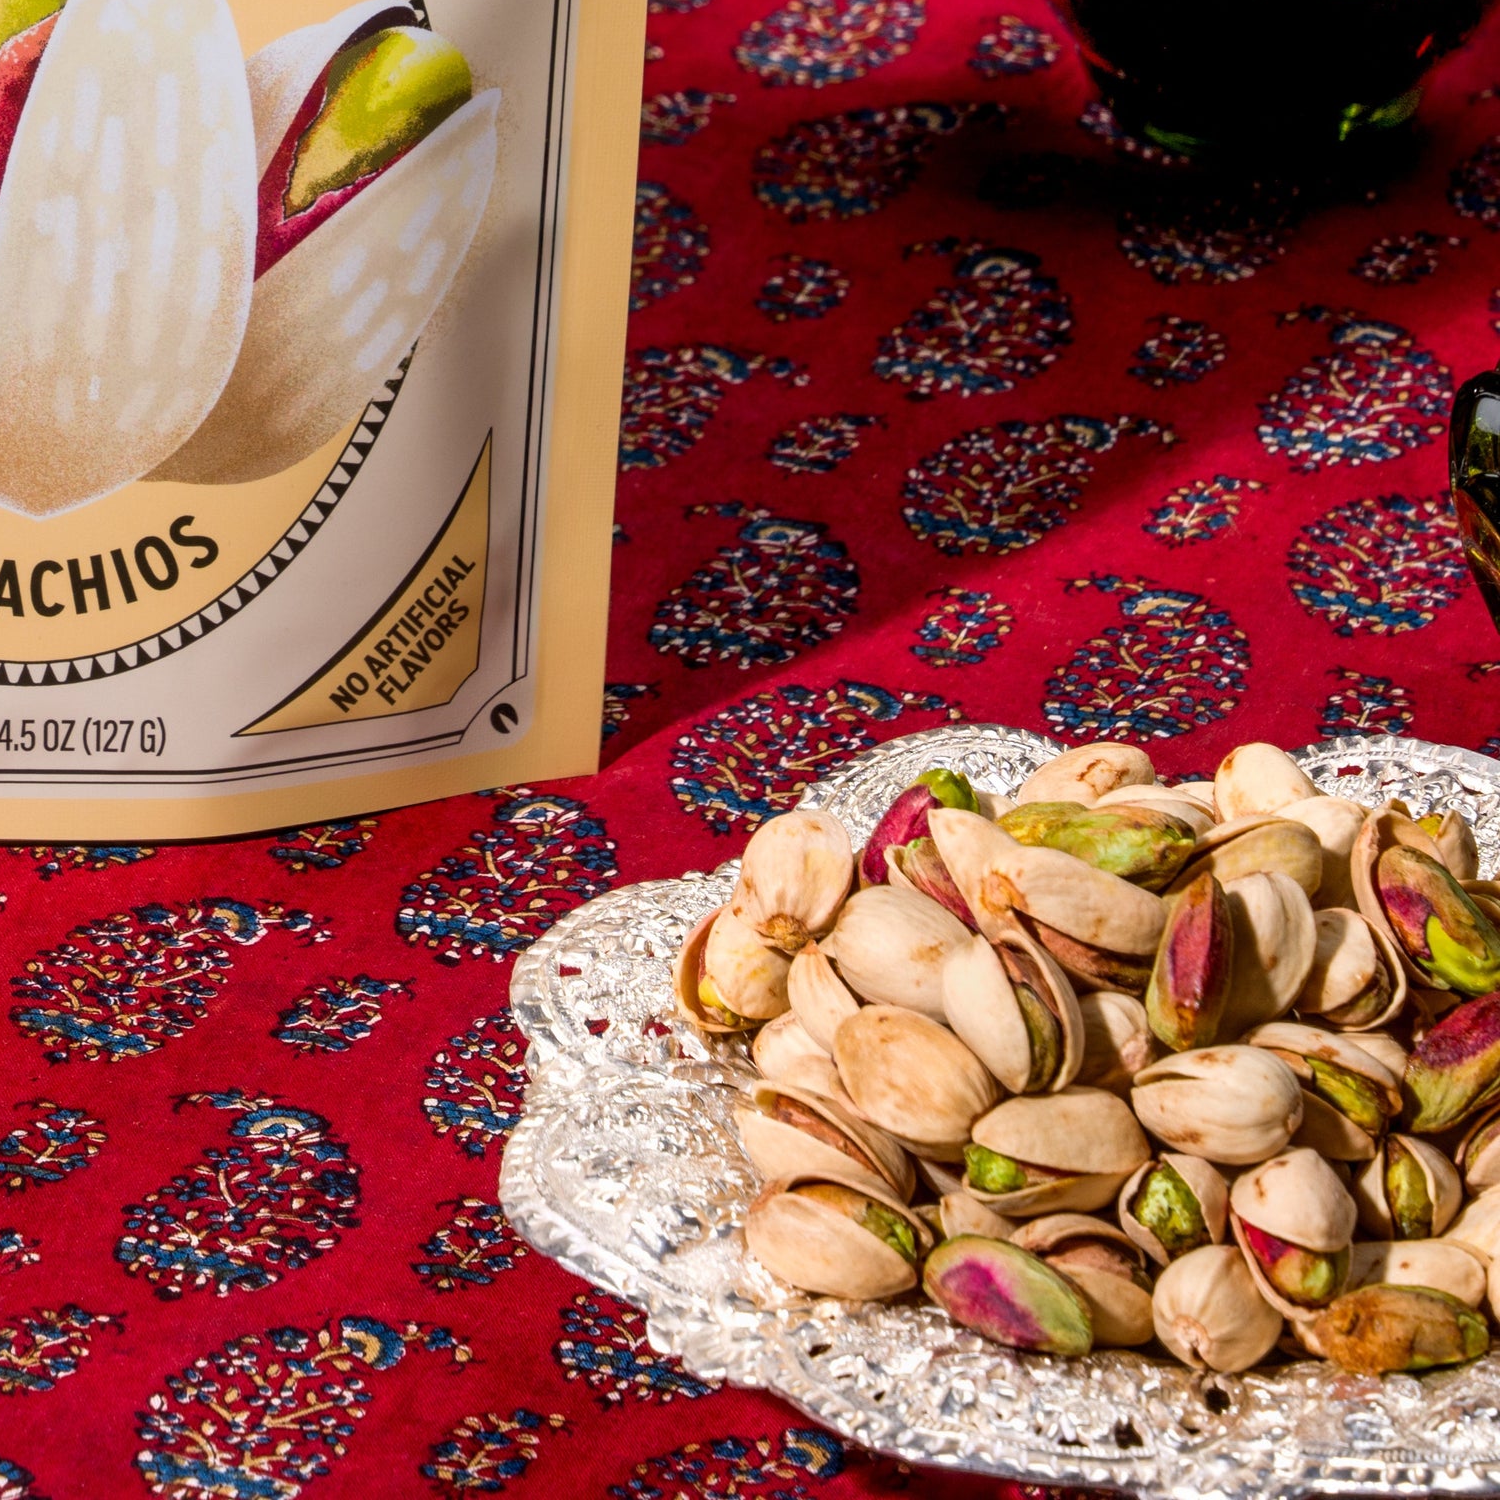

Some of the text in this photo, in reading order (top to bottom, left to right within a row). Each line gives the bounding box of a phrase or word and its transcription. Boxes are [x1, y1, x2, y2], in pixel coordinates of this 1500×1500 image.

[329, 555, 476, 713] NO ARTIFICIAL
[375, 598, 470, 705] FLAVORS
[44, 719, 75, 751] OZ
[83, 717, 134, 755] (127
[140, 717, 166, 756] G)
